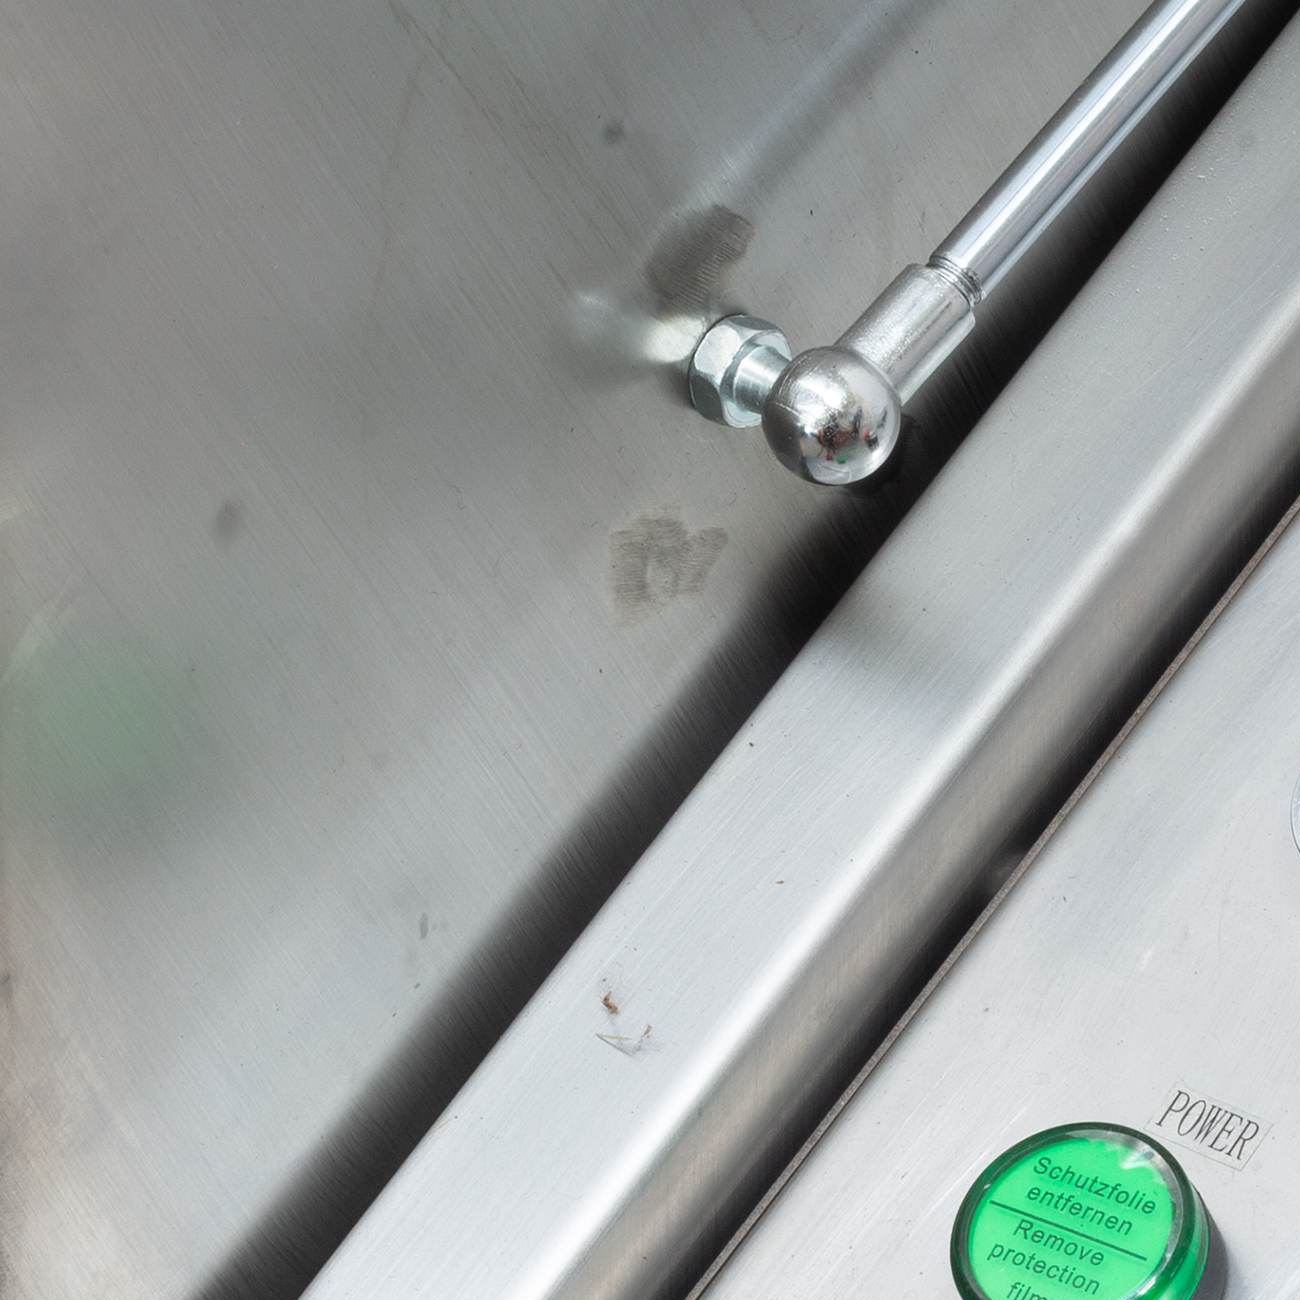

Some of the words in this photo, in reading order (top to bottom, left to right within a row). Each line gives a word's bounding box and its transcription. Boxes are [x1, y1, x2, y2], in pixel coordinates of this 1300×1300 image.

[1155, 1090, 1260, 1161] POWER
[1027, 1184, 1133, 1236] entfernen
[1033, 1157, 1156, 1214] Schutzfolie
[987, 1242, 1100, 1295] protection
[1013, 1219, 1105, 1266] Remove
